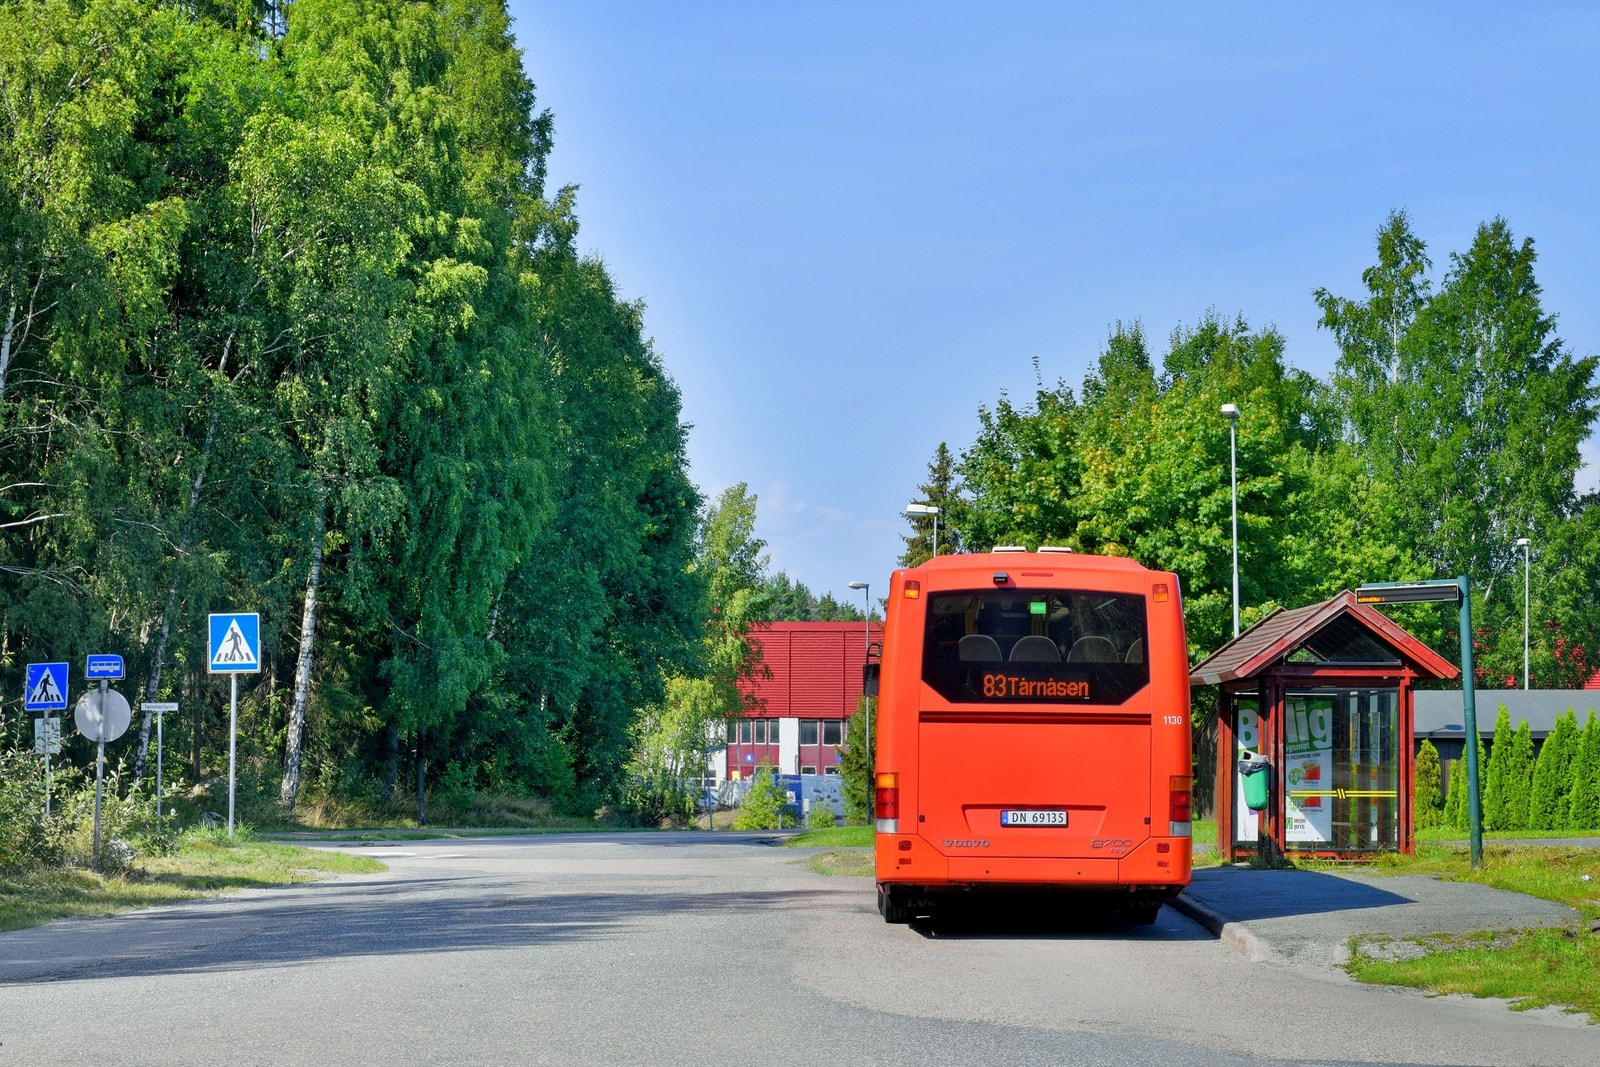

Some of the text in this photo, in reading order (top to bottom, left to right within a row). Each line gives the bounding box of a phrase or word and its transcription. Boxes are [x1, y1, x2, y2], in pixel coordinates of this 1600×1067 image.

[983, 673, 1089, 697] 83 Tårnåsen
[1163, 716, 1182, 724] 1130
[1012, 812, 1026, 822] DN
[1032, 812, 1064, 823] 69135
[943, 839, 990, 848] VOLVO
[1092, 839, 1132, 848] 8700
